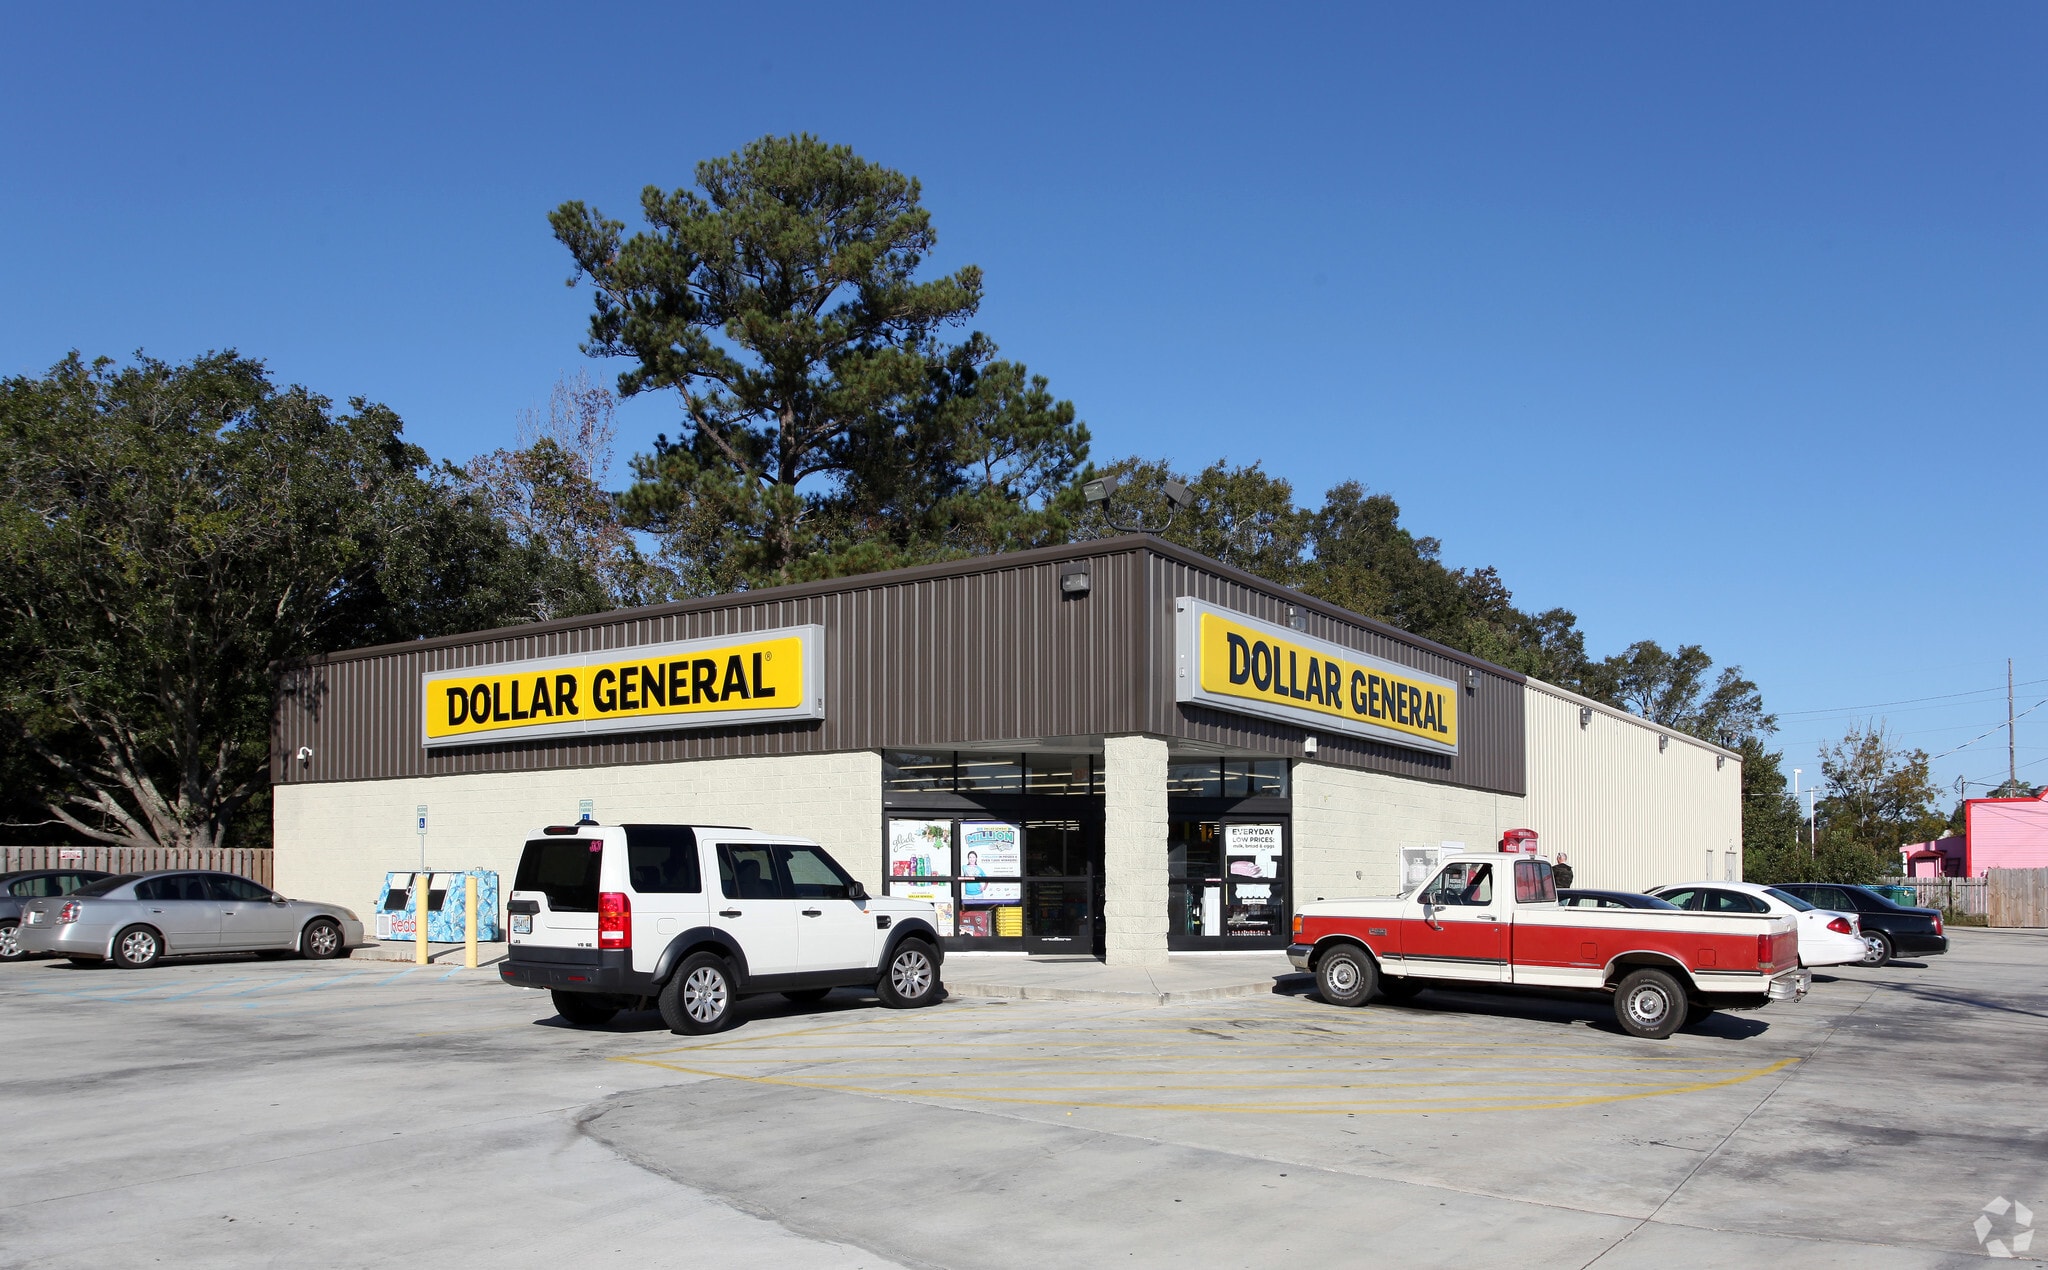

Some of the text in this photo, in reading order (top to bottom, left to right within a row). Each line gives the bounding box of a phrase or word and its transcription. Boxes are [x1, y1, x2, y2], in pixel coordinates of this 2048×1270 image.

[446, 673, 579, 726] DOLLAR
[1226, 632, 1448, 734] DOLLAR GENERAL
[967, 831, 1013, 842] MILLION
[392, 914, 416, 932] Redd
